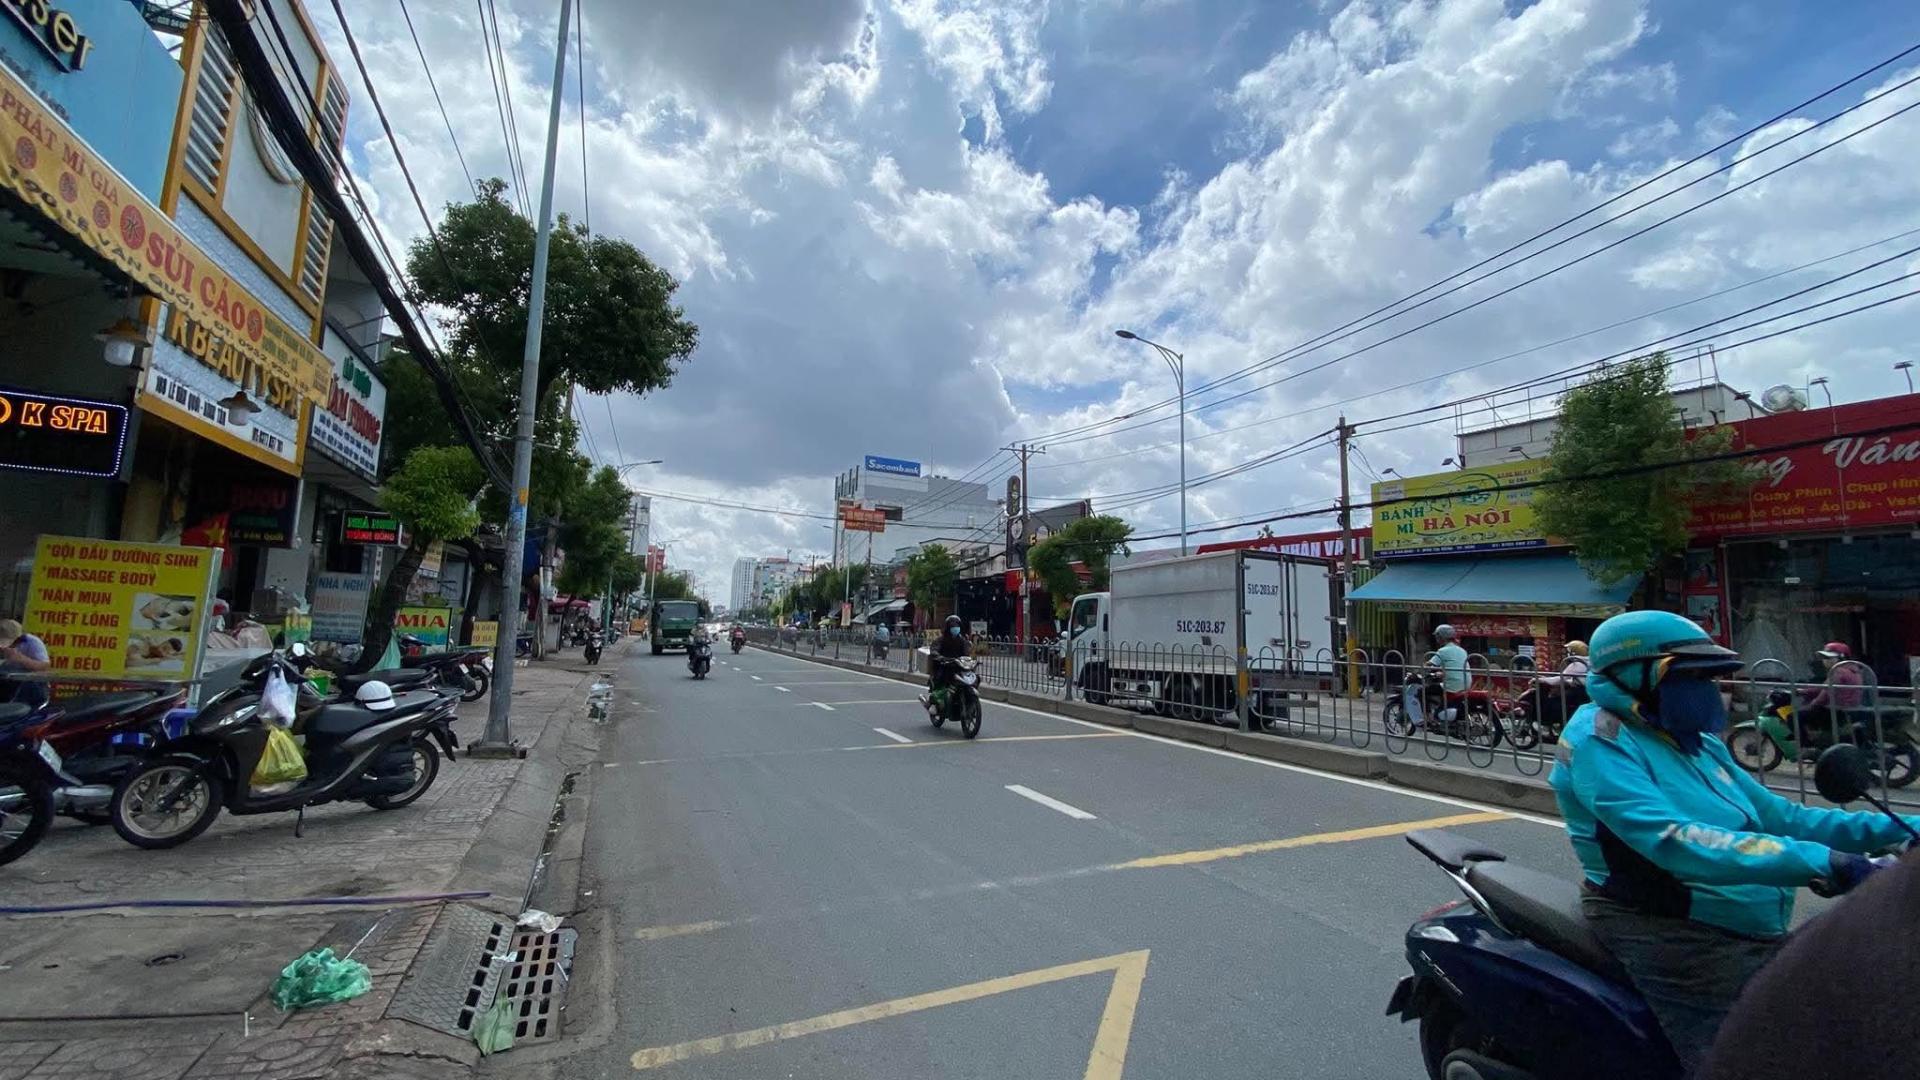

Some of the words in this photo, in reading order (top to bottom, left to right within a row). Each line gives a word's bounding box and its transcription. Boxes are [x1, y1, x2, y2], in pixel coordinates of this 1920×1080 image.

[21, 401, 45, 426] K
[50, 405, 107, 434] SPA
[868, 459, 919, 474] Sacombank
[1381, 504, 1424, 521] BÁNH
[1423, 515, 1455, 531] HÀ
[1465, 508, 1511, 527] NỘI
[164, 551, 199, 568] SINH
[47, 566, 116, 584] MASSAGE
[120, 571, 157, 586] BODY
[1247, 583, 1279, 596] 51C-203.87
[1176, 620, 1226, 634] 51C-203.87
